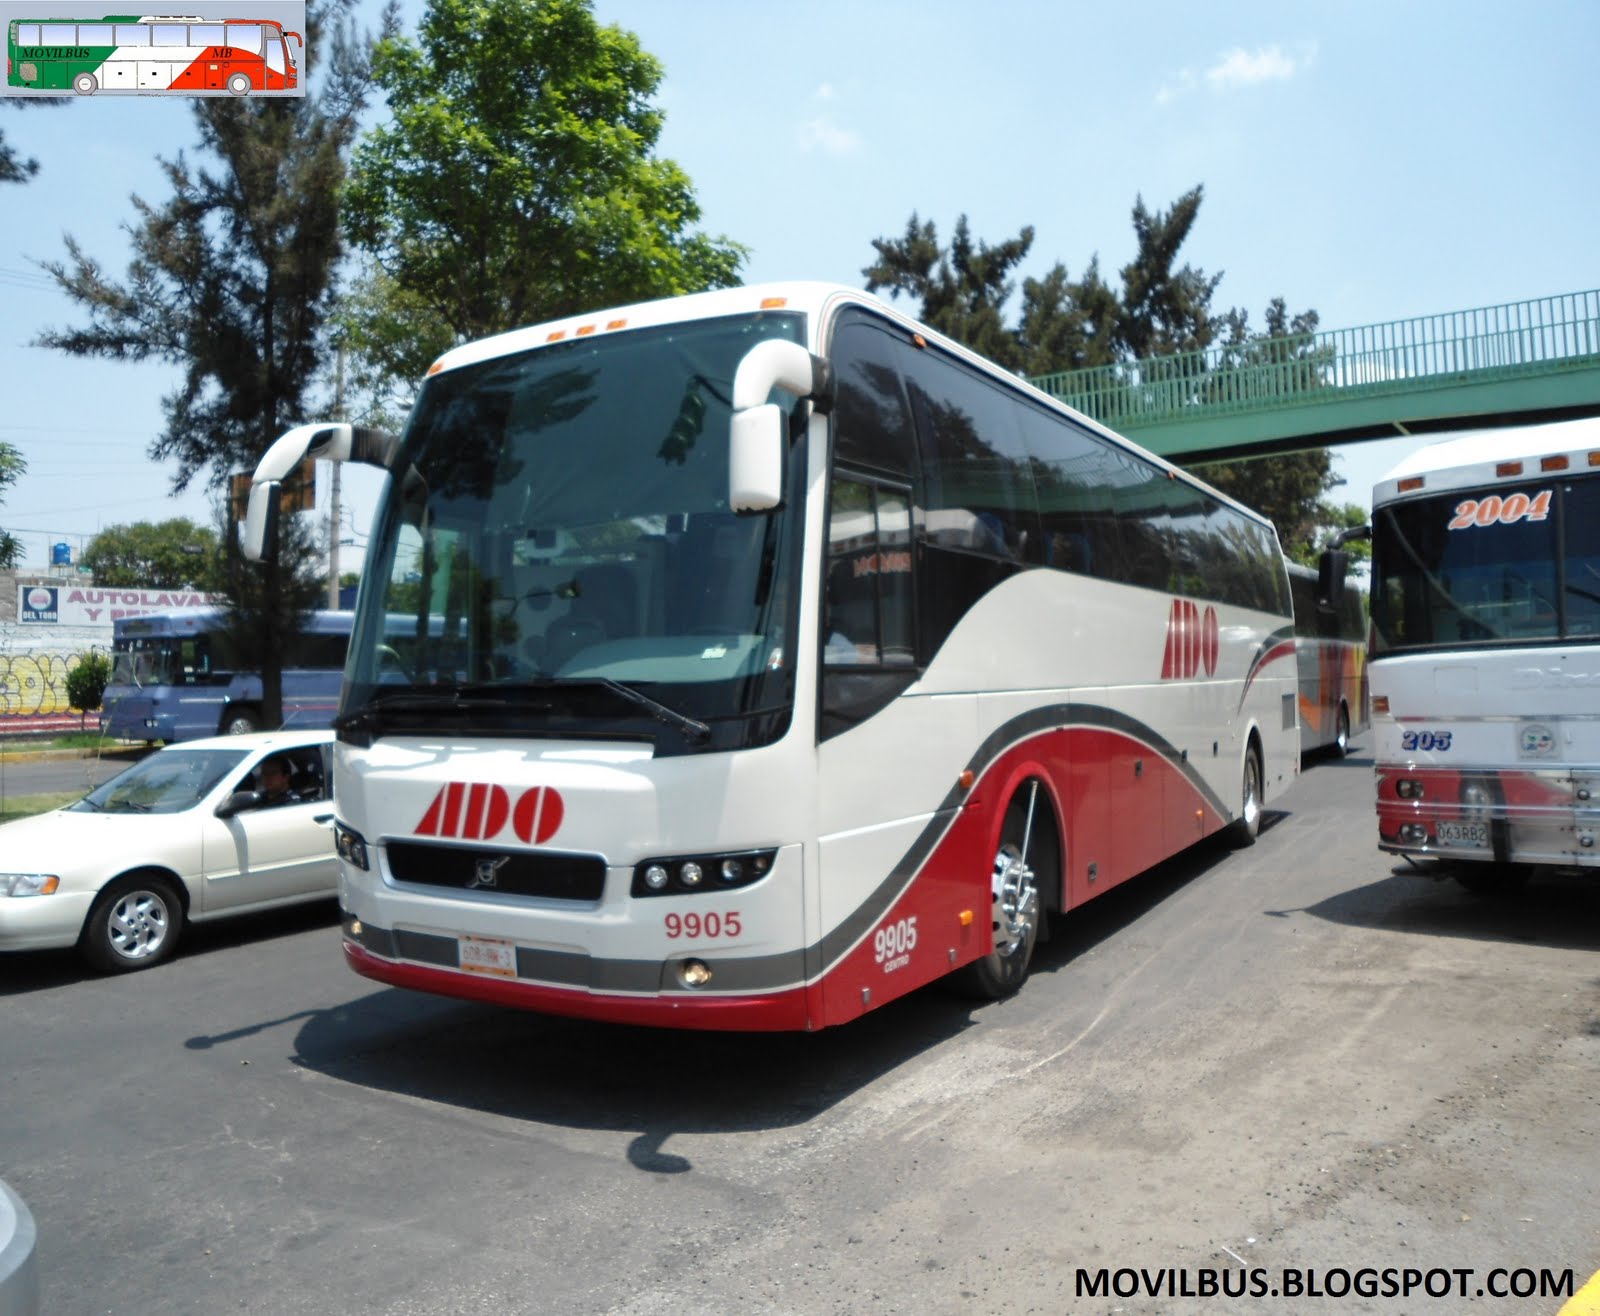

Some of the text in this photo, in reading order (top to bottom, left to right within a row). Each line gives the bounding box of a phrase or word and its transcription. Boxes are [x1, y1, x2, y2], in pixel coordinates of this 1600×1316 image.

[1448, 490, 1553, 530] 2004
[1161, 598, 1219, 680] ADO
[1402, 731, 1452, 751] 205
[414, 781, 564, 845] ADO
[664, 911, 743, 939] 9905
[875, 916, 917, 963] 9905
